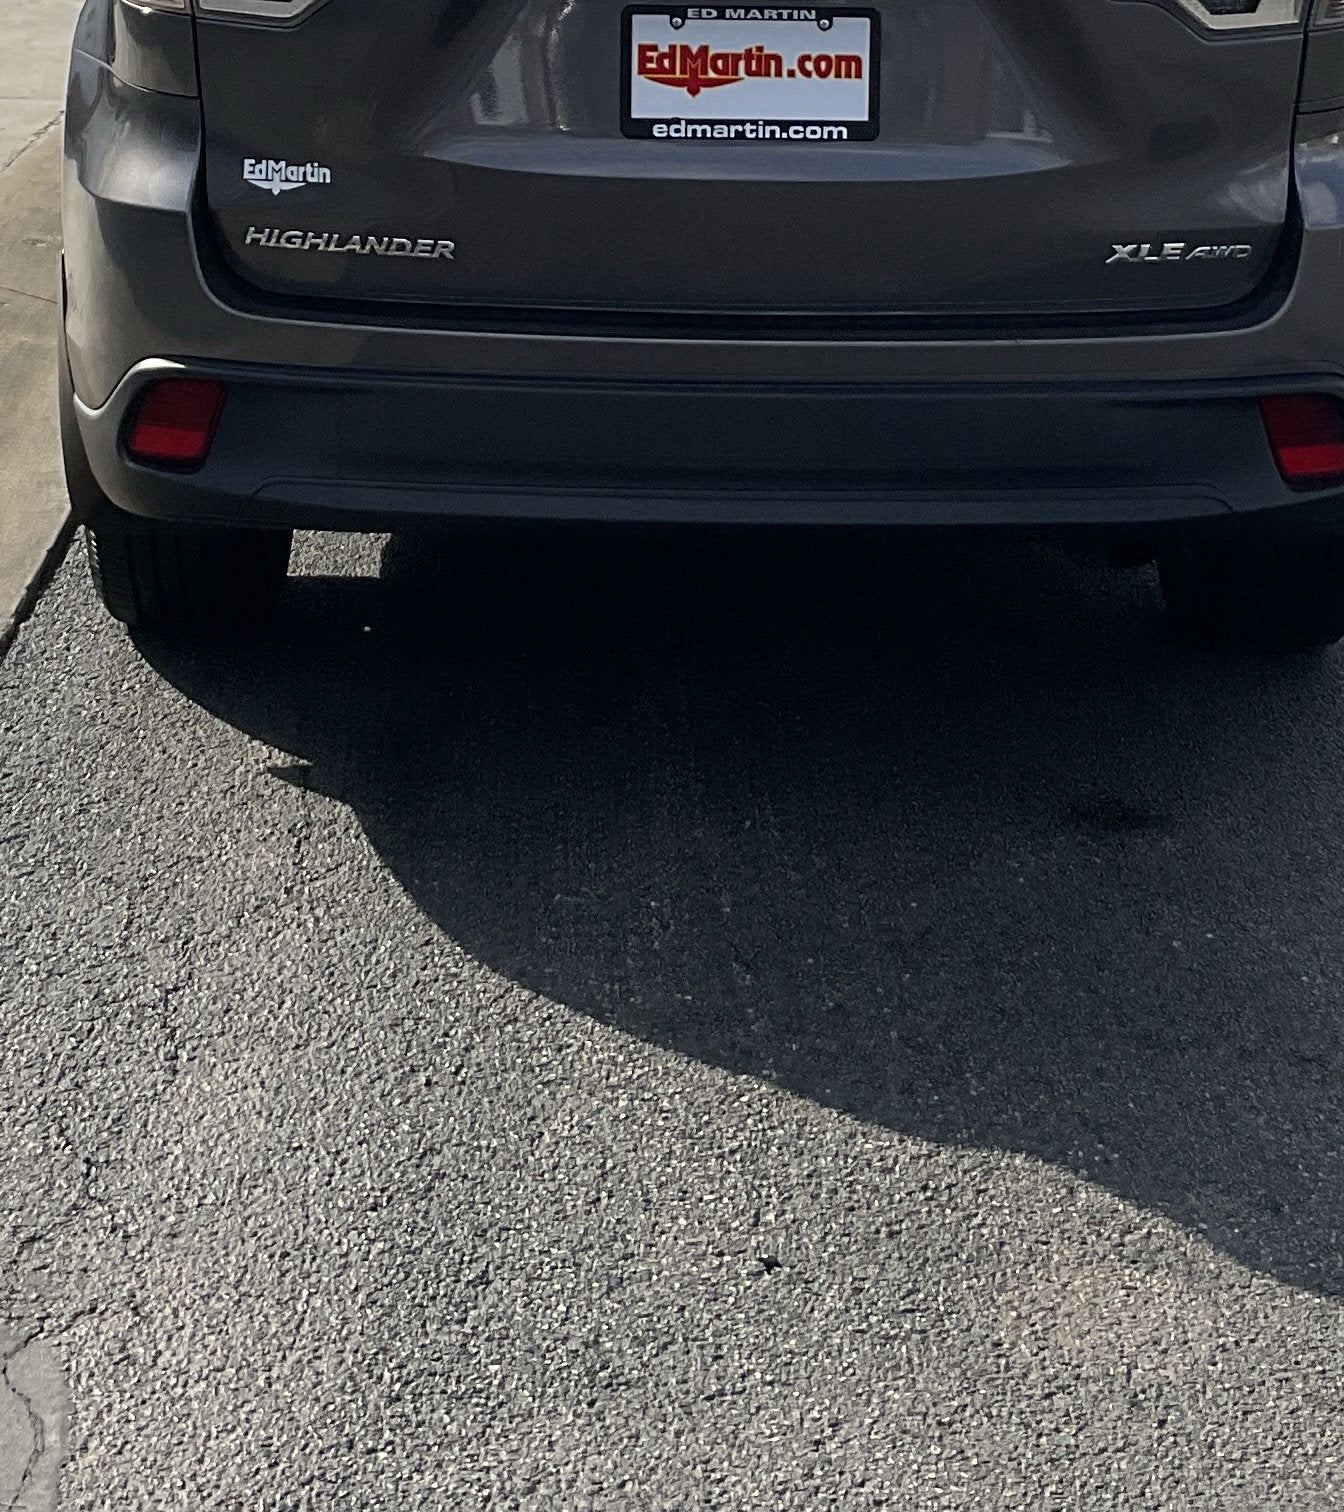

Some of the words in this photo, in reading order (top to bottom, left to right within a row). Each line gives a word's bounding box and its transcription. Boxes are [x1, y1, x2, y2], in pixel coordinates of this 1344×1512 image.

[687, 7, 718, 19] ED
[725, 8, 817, 20] MARTIN
[636, 43, 864, 86] EdMartin.com
[652, 119, 848, 141] edmartin.com
[242, 158, 332, 187] EdMartin
[244, 225, 455, 261] HIGHLANDER
[1104, 242, 1186, 264] XLE
[1186, 244, 1253, 260] AWD
